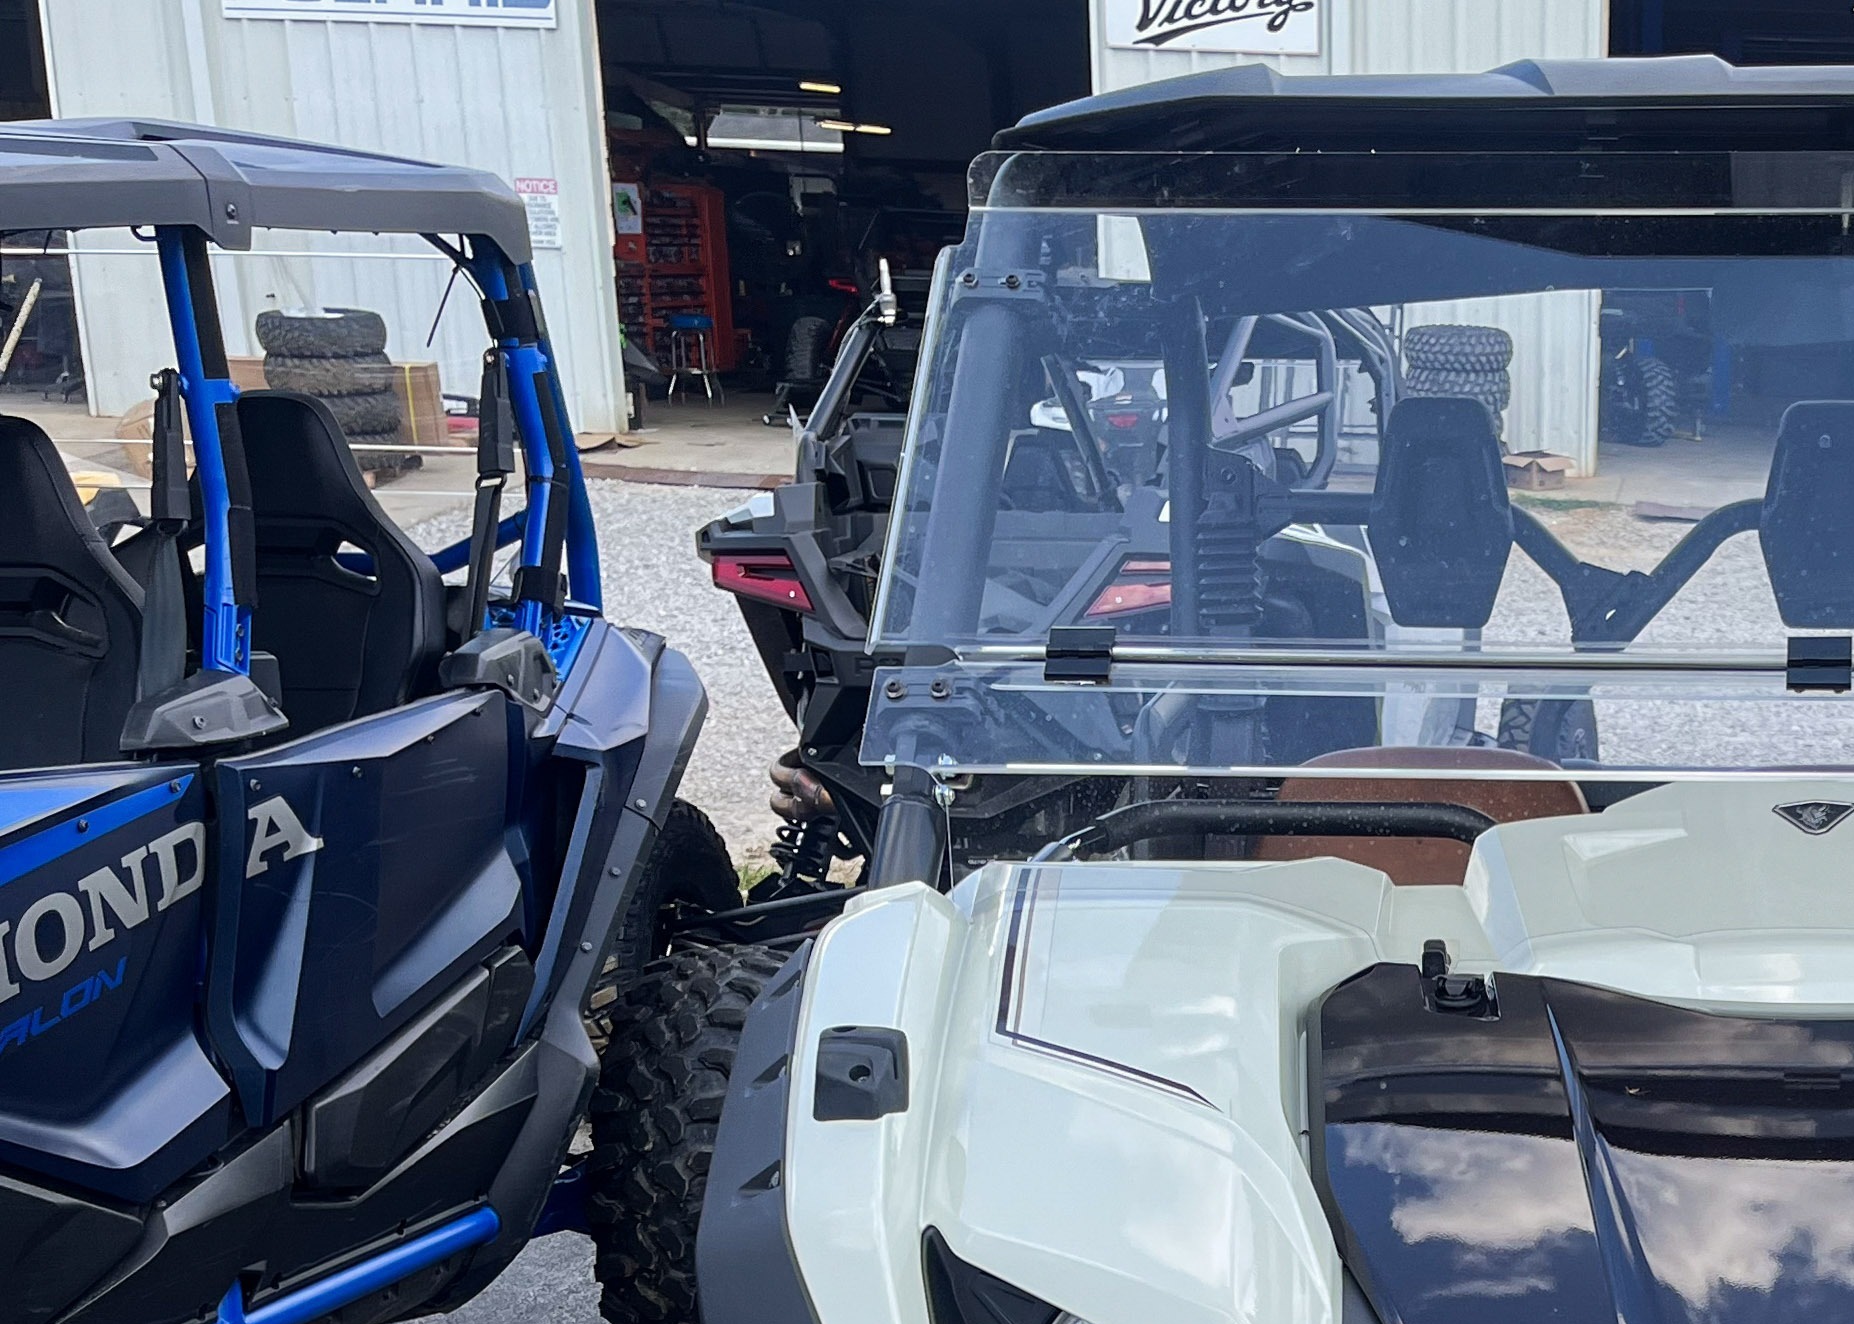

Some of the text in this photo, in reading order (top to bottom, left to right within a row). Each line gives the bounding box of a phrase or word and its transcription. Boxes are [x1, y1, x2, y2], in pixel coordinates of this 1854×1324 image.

[515, 179, 557, 194] NOTICE
[0, 795, 325, 1002] ONDA
[0, 951, 128, 1053] ALON
